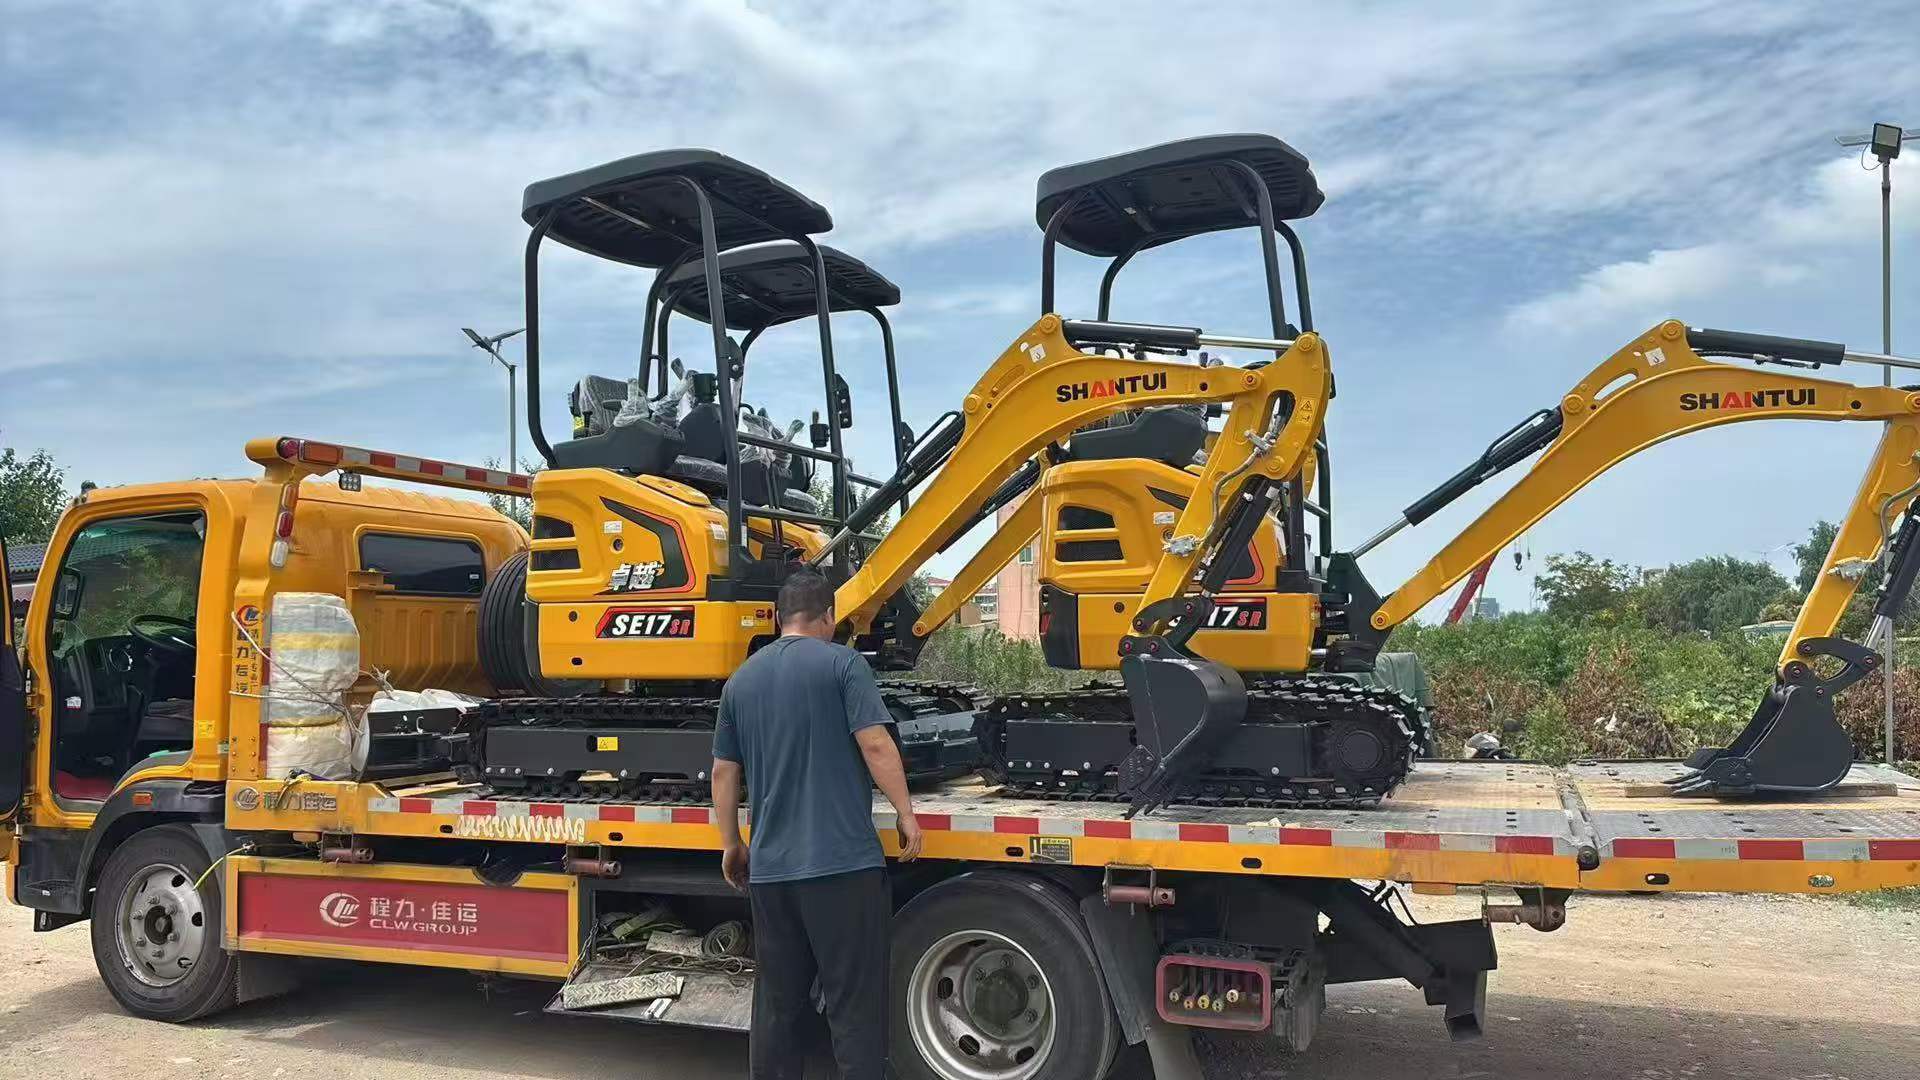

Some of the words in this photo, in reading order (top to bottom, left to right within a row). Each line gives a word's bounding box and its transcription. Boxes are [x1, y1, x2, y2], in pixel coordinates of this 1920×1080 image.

[1056, 371, 1167, 402] SHANTUI
[1679, 388, 1816, 411] SHANTUI
[609, 561, 664, 591] 卓越
[369, 918, 409, 930] CLW
[412, 921, 478, 936] GROUP
